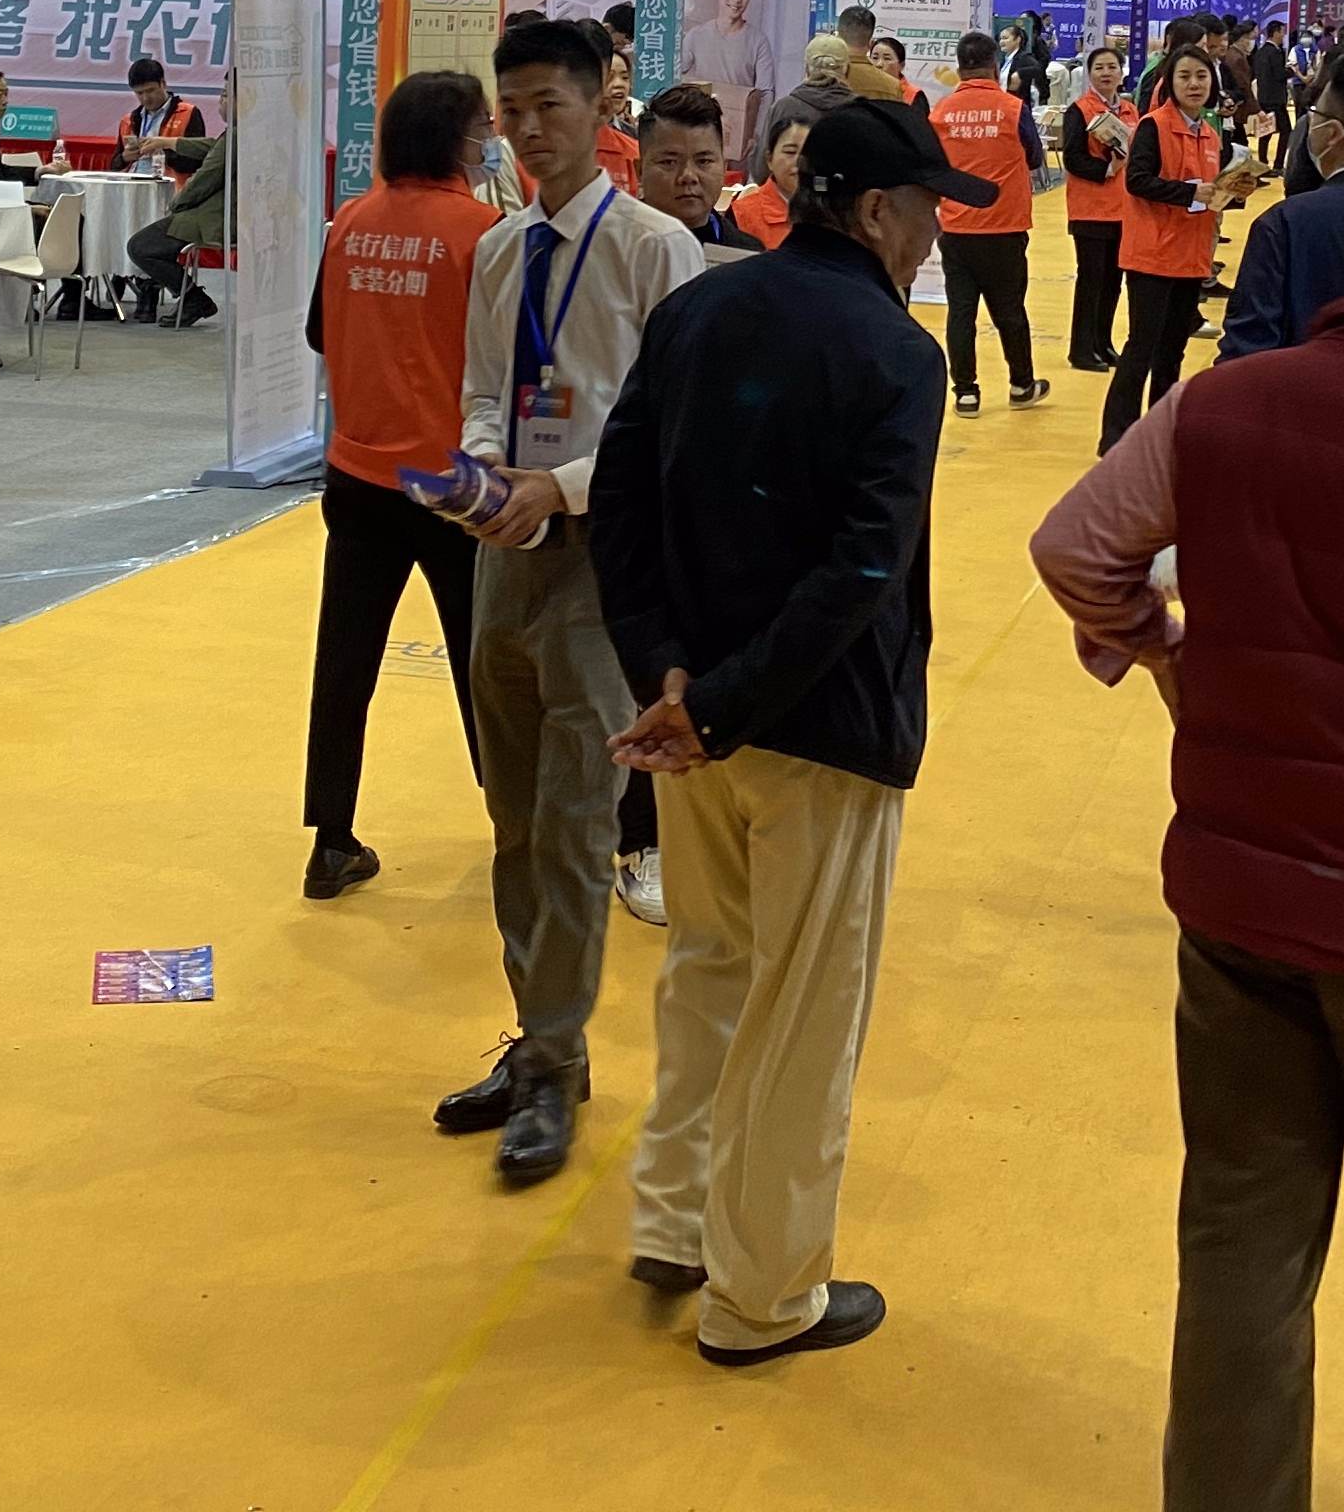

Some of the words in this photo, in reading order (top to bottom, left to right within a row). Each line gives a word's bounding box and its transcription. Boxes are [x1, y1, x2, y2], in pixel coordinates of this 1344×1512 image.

[943, 109, 1006, 126] 农行信用卡
